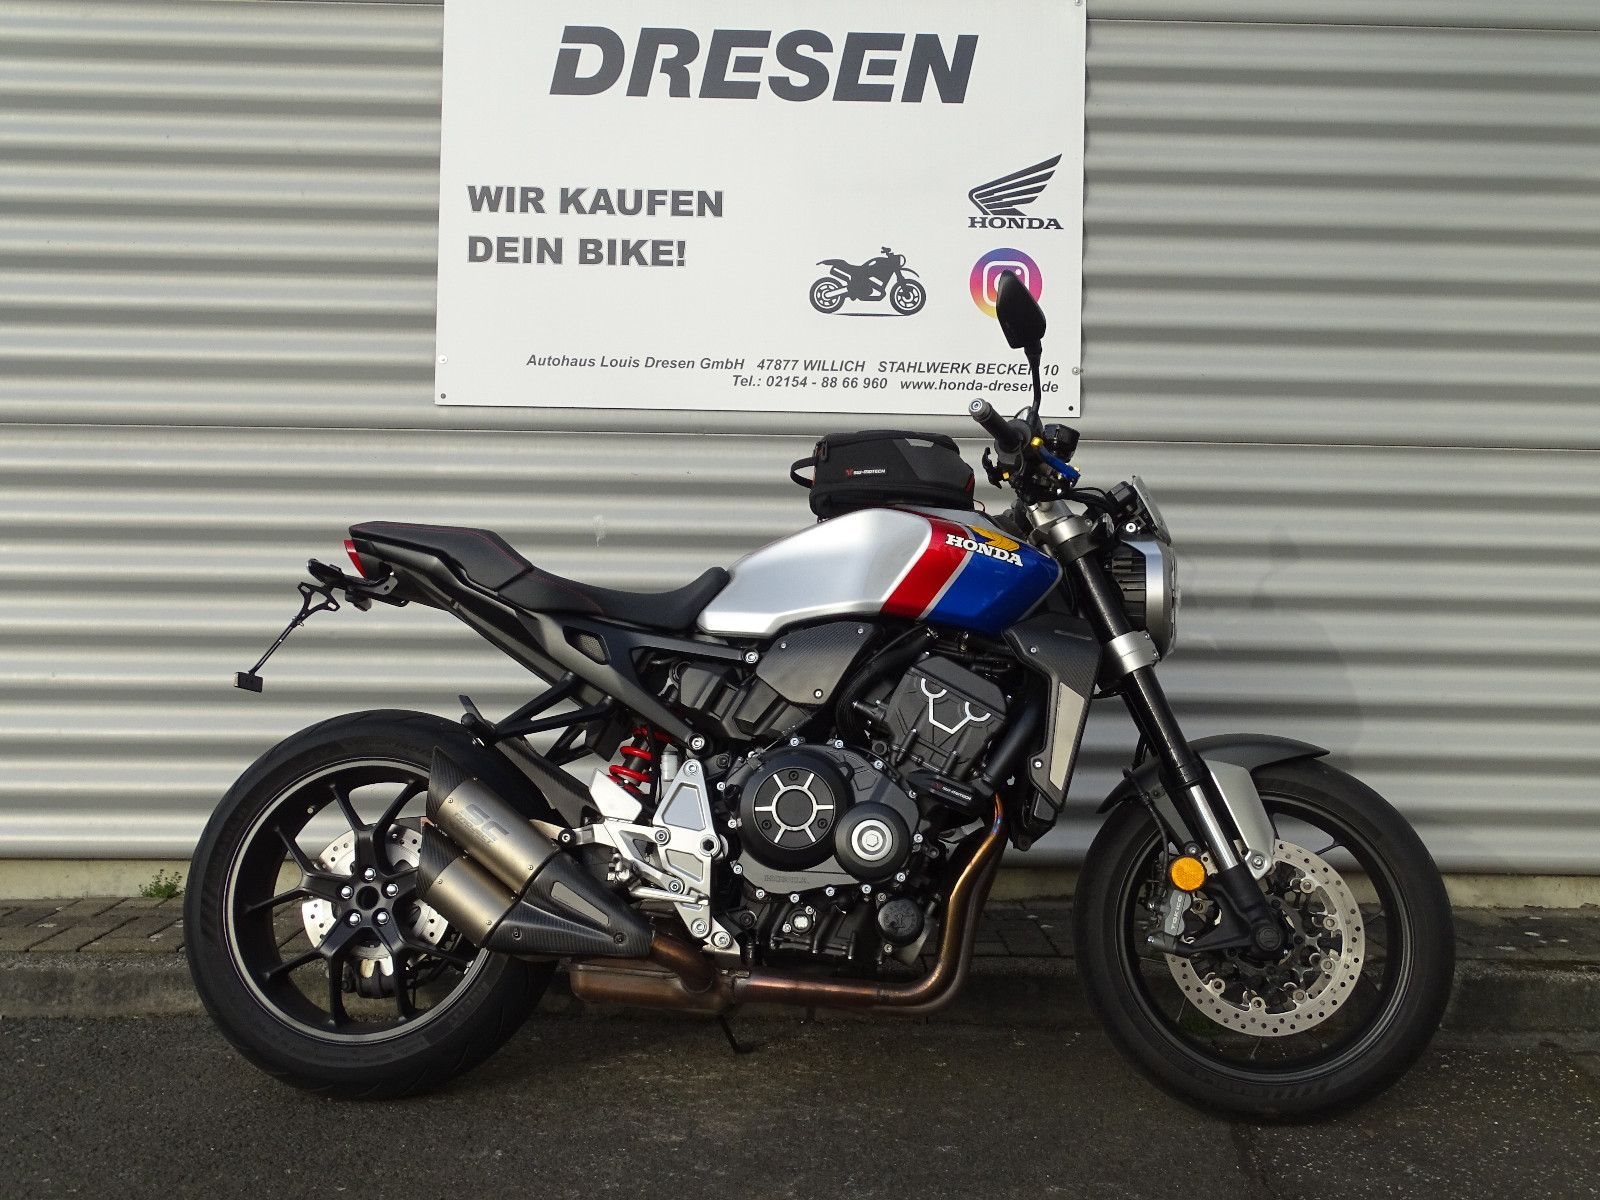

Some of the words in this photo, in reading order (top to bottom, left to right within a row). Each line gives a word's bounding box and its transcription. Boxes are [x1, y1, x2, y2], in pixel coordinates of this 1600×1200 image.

[550, 26, 978, 103] DRESEN
[468, 185, 546, 214] WIR
[560, 187, 723, 217] KAUFEN
[968, 216, 1064, 230] HONDA
[468, 236, 563, 265] DEIN
[579, 238, 686, 267] BIKE!
[526, 355, 596, 368] Autohaus
[600, 356, 640, 369] Louis
[644, 357, 695, 370] Dresen
[700, 358, 745, 370] GmbH
[756, 359, 799, 371] 47877
[803, 360, 866, 372] WILLICH
[878, 361, 971, 374] STAHLWERK
[1043, 364, 1060, 376] 10
[732, 375, 762, 387] Tel.:
[765, 376, 808, 388] 02154
[821, 377, 838, 389] 88
[842, 377, 859, 389] 66
[863, 378, 888, 390] 960
[900, 378, 1059, 393] www.honda-dresede
[945, 533, 1024, 567] HONDA
[1171, 895, 1182, 930] TOKICO
